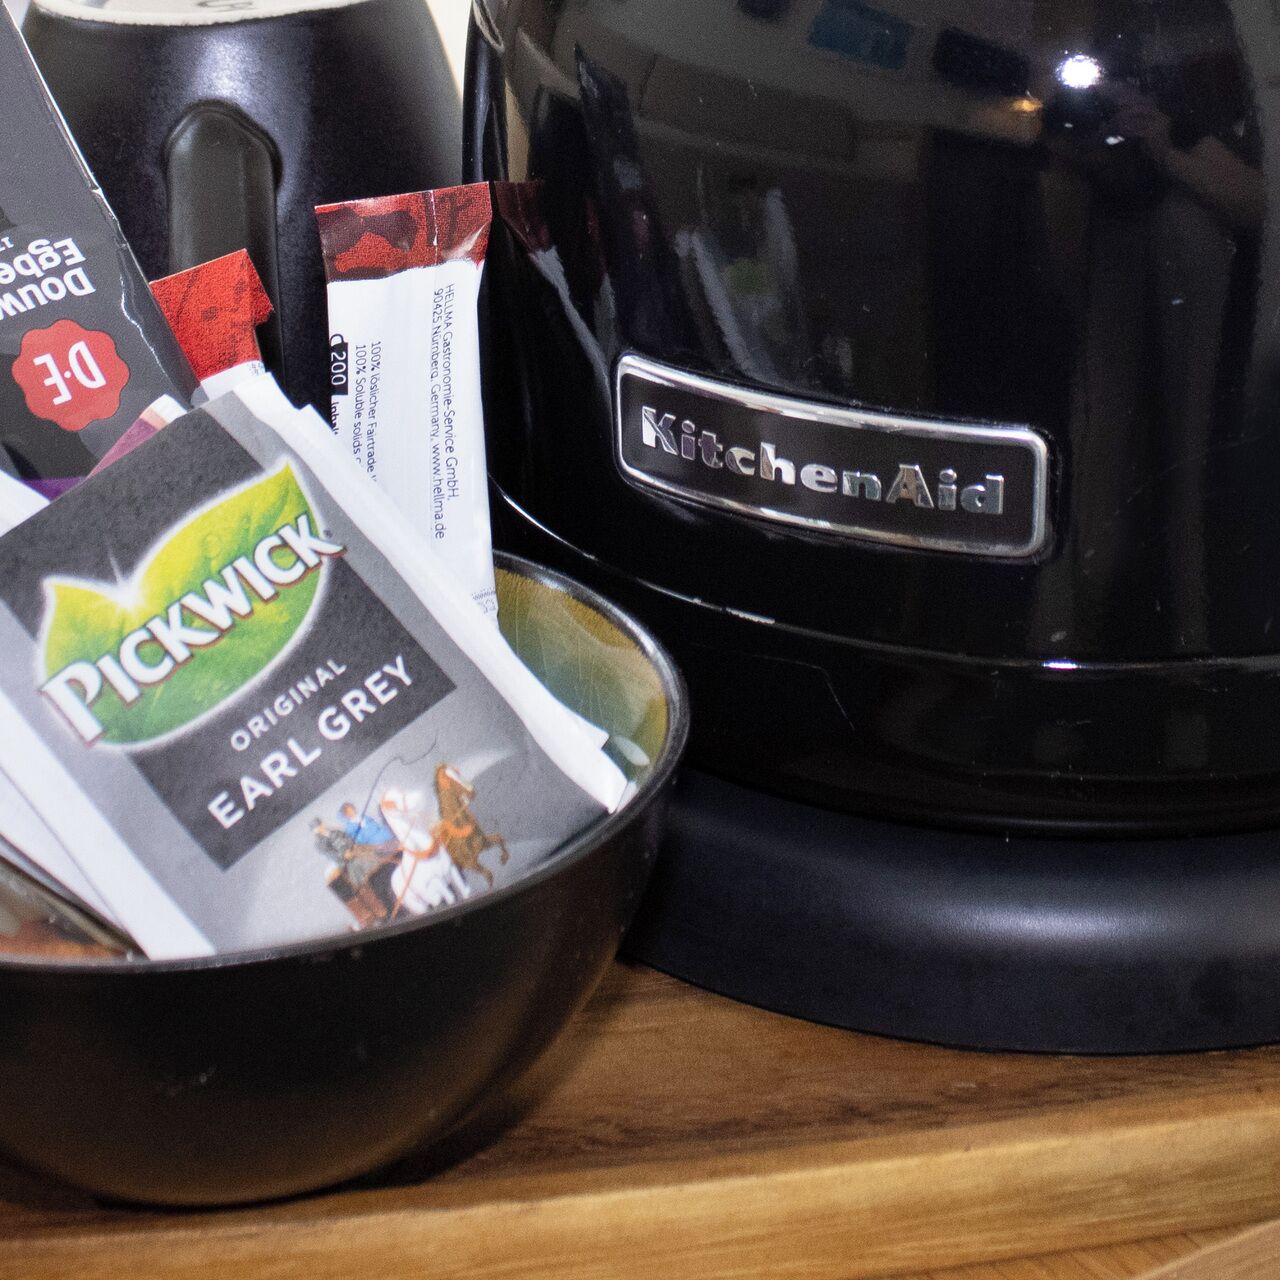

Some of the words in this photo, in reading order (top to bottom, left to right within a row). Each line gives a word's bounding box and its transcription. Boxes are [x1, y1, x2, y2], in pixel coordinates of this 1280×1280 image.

[432, 288, 444, 323] 90425
[442, 283, 455, 329] HELLMA
[331, 351, 347, 386] 200
[355, 344, 367, 375] 100%
[371, 340, 381, 371] 100%
[353, 378, 367, 420] Soluble
[369, 372, 380, 420] löslicher
[442, 331, 456, 453] Gastronomie-Service
[352, 421, 362, 456] solids
[367, 422, 378, 473] Fairtrade
[641, 406, 1005, 515] KitchenAid
[432, 443, 447, 539] www.hellma.de
[40, 513, 347, 746] PICKWICK
[230, 658, 347, 752] ORIGINAL
[207, 737, 322, 829] EARL
[318, 654, 413, 741] GREY
